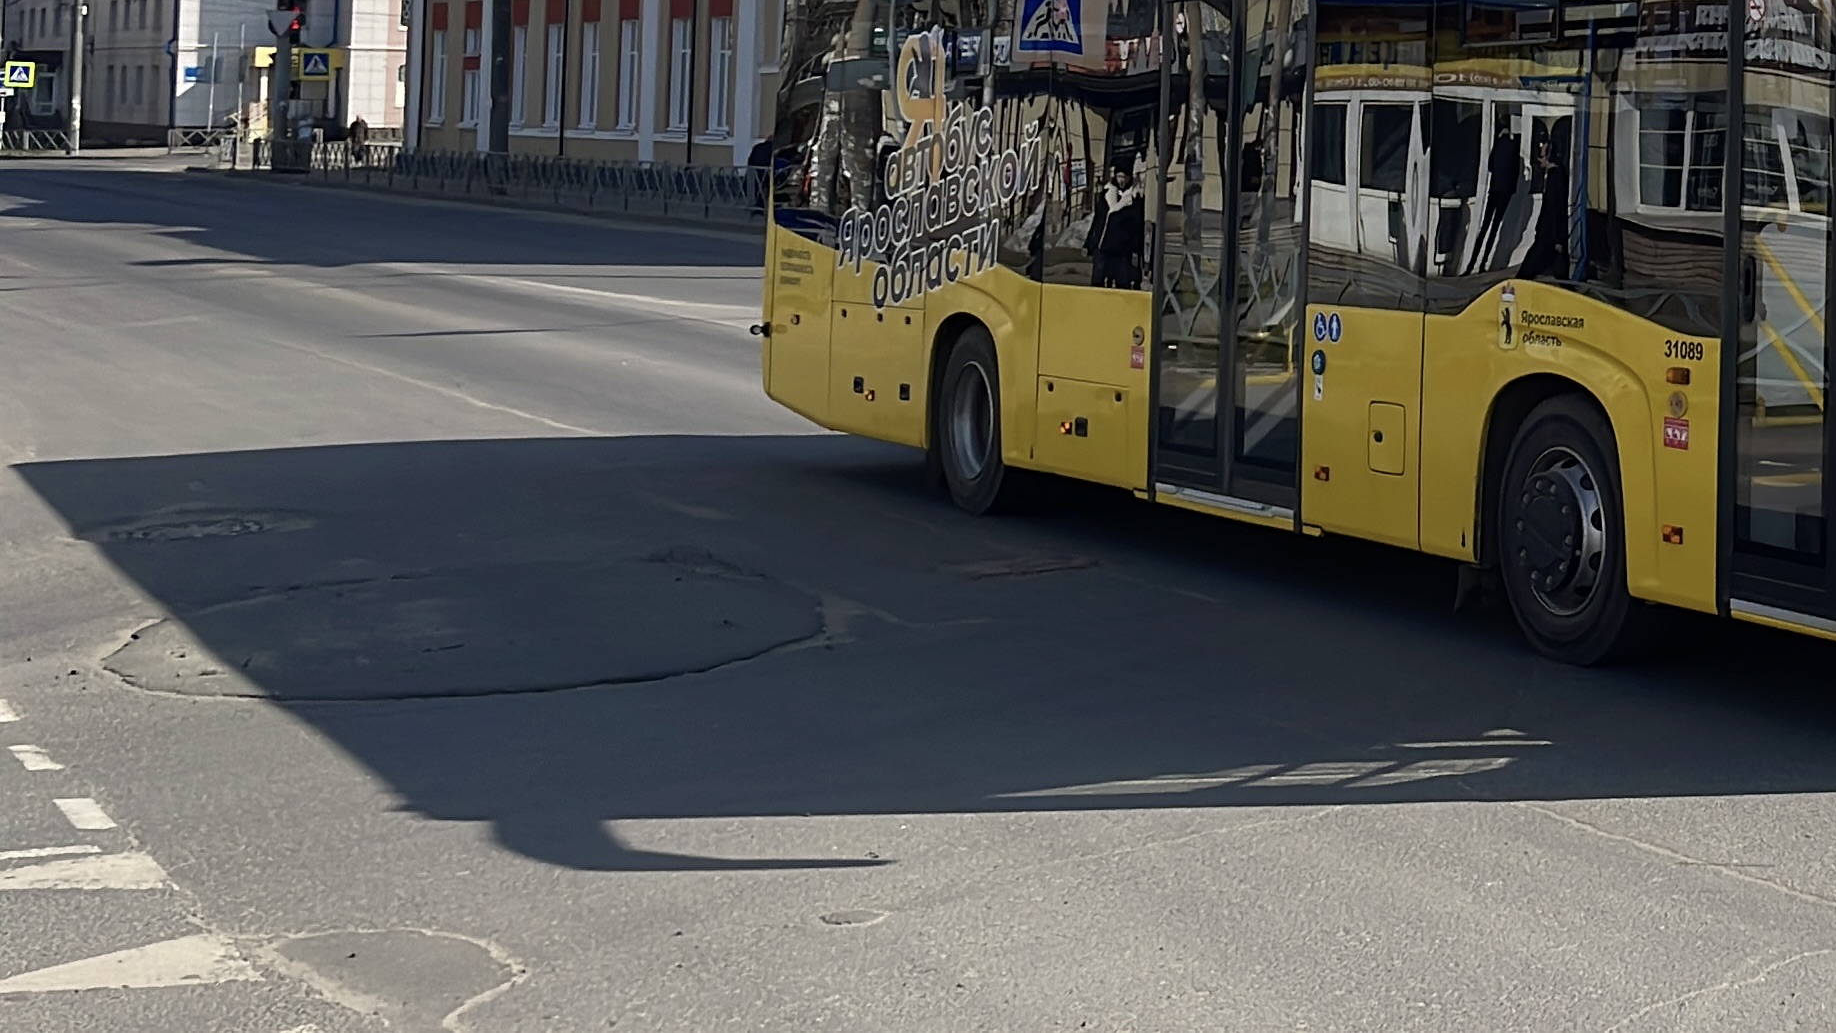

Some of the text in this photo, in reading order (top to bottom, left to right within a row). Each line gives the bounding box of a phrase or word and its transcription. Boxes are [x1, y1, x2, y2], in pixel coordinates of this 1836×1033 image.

[885, 101, 993, 200] автобус
[873, 217, 1001, 309] области
[1521, 310, 1585, 328] Ярославская
[1522, 330, 1562, 347] область
[1664, 339, 1704, 361] 31089
